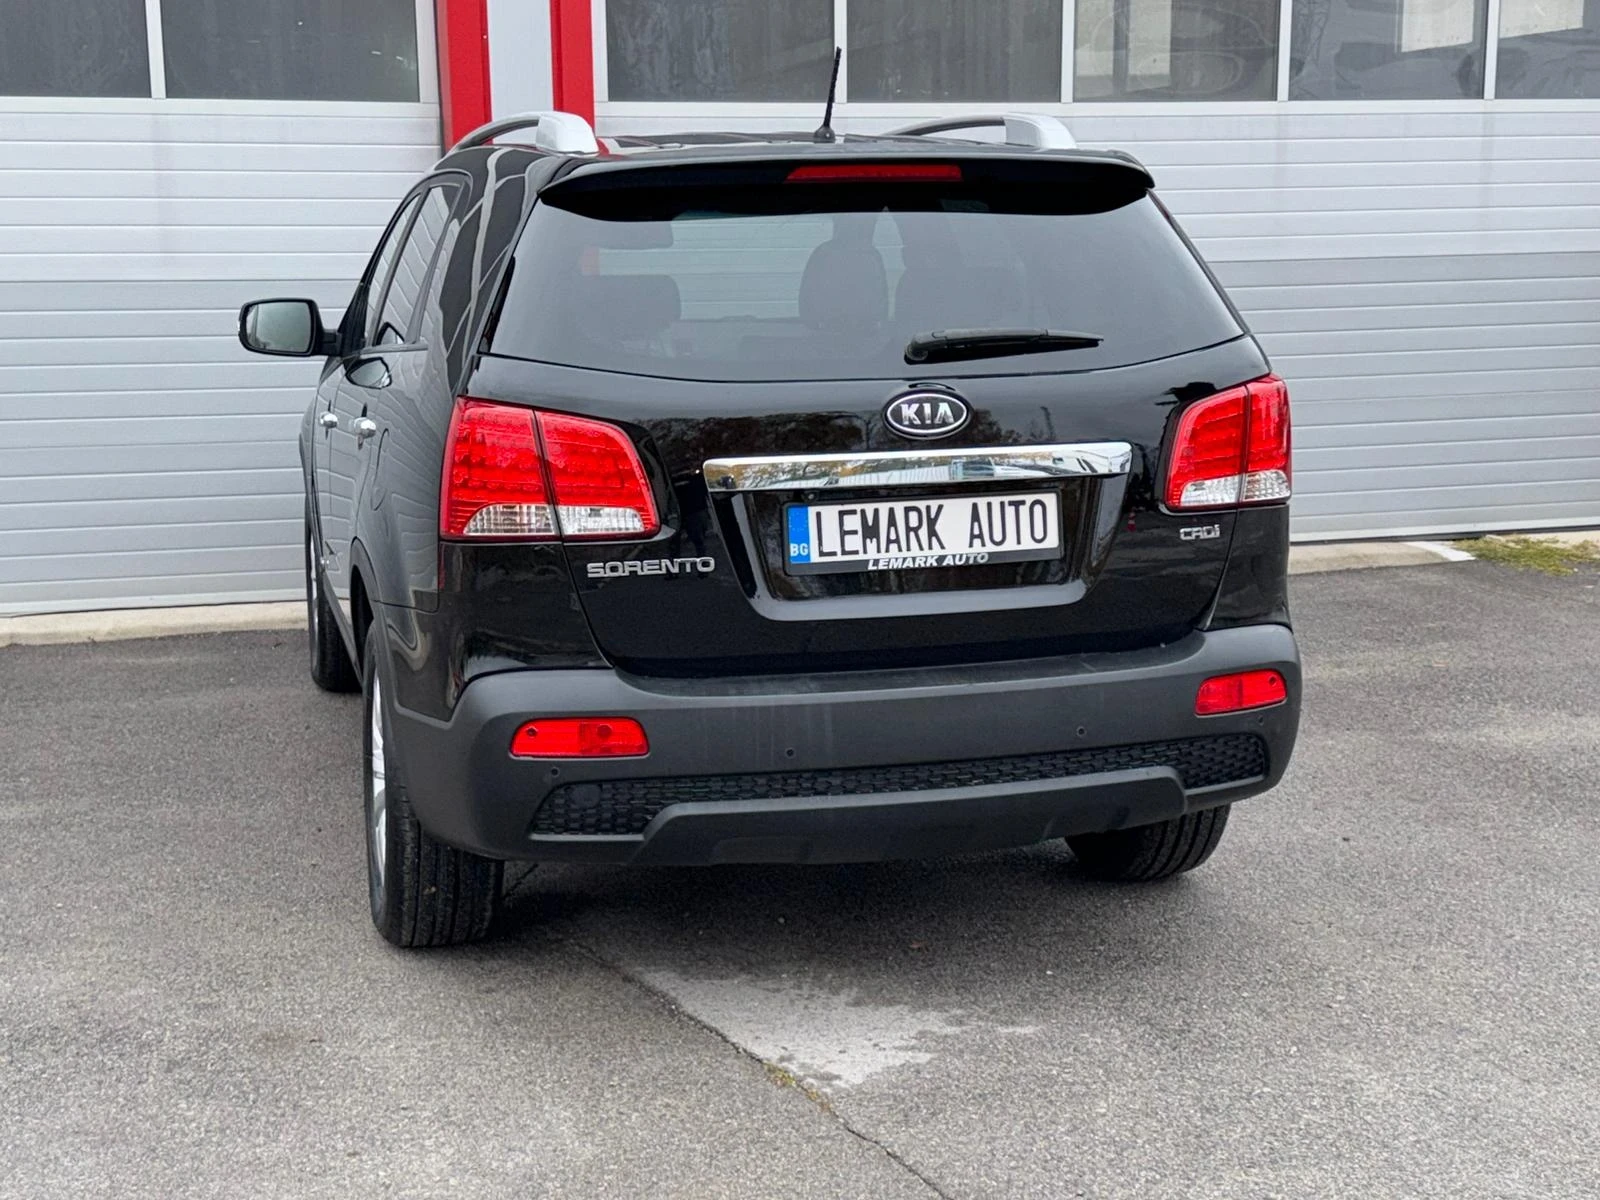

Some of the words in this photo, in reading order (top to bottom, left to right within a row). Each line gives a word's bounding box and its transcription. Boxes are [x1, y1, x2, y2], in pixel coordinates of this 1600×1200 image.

[900, 402, 955, 425] KIA
[815, 503, 947, 557] LEMARK
[968, 498, 1049, 549] AUTO
[789, 543, 809, 558] BG
[867, 554, 939, 571] LEMARK
[943, 551, 990, 567] AUTO
[586, 556, 716, 578] SORENTO
